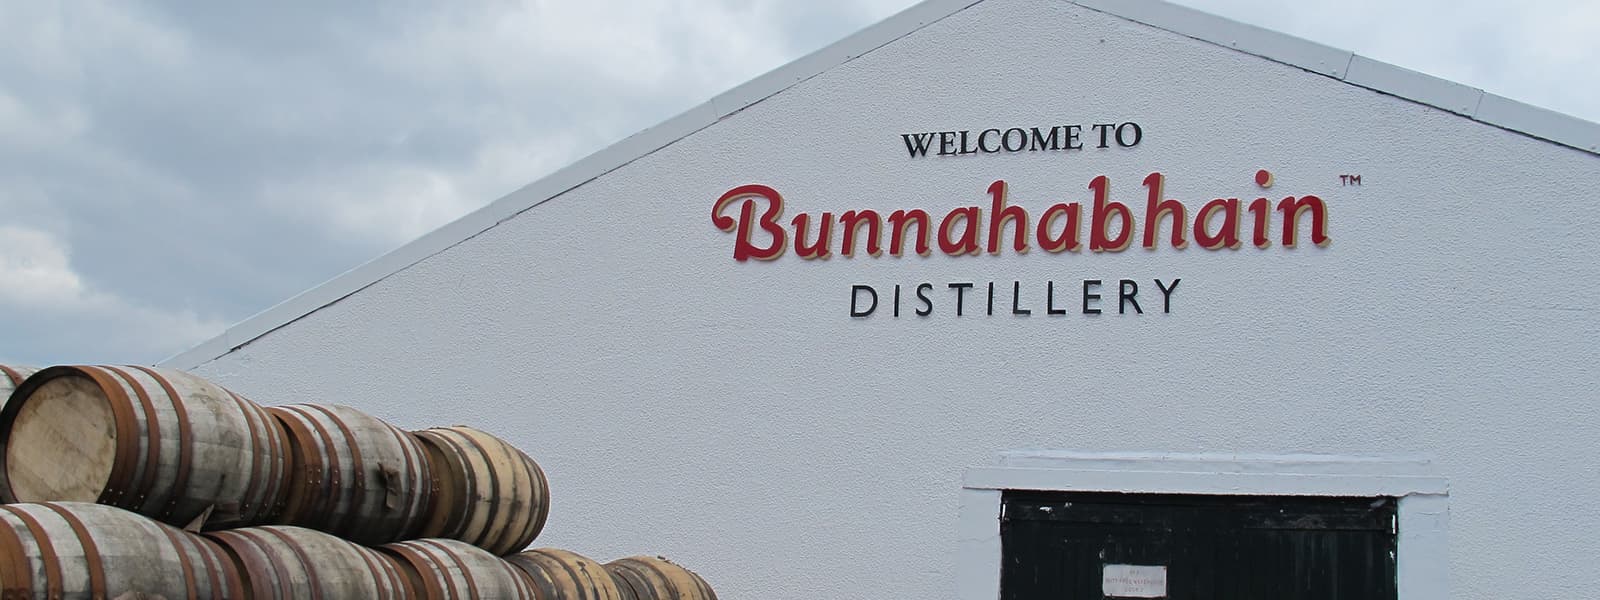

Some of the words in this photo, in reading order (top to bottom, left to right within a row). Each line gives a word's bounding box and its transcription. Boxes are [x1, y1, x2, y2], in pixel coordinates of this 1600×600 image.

[901, 125, 1083, 158] WELCOME
[1092, 122, 1142, 149] TO
[712, 170, 1331, 263] Bunnahabhain
[851, 279, 1182, 318] DISTILLERY
